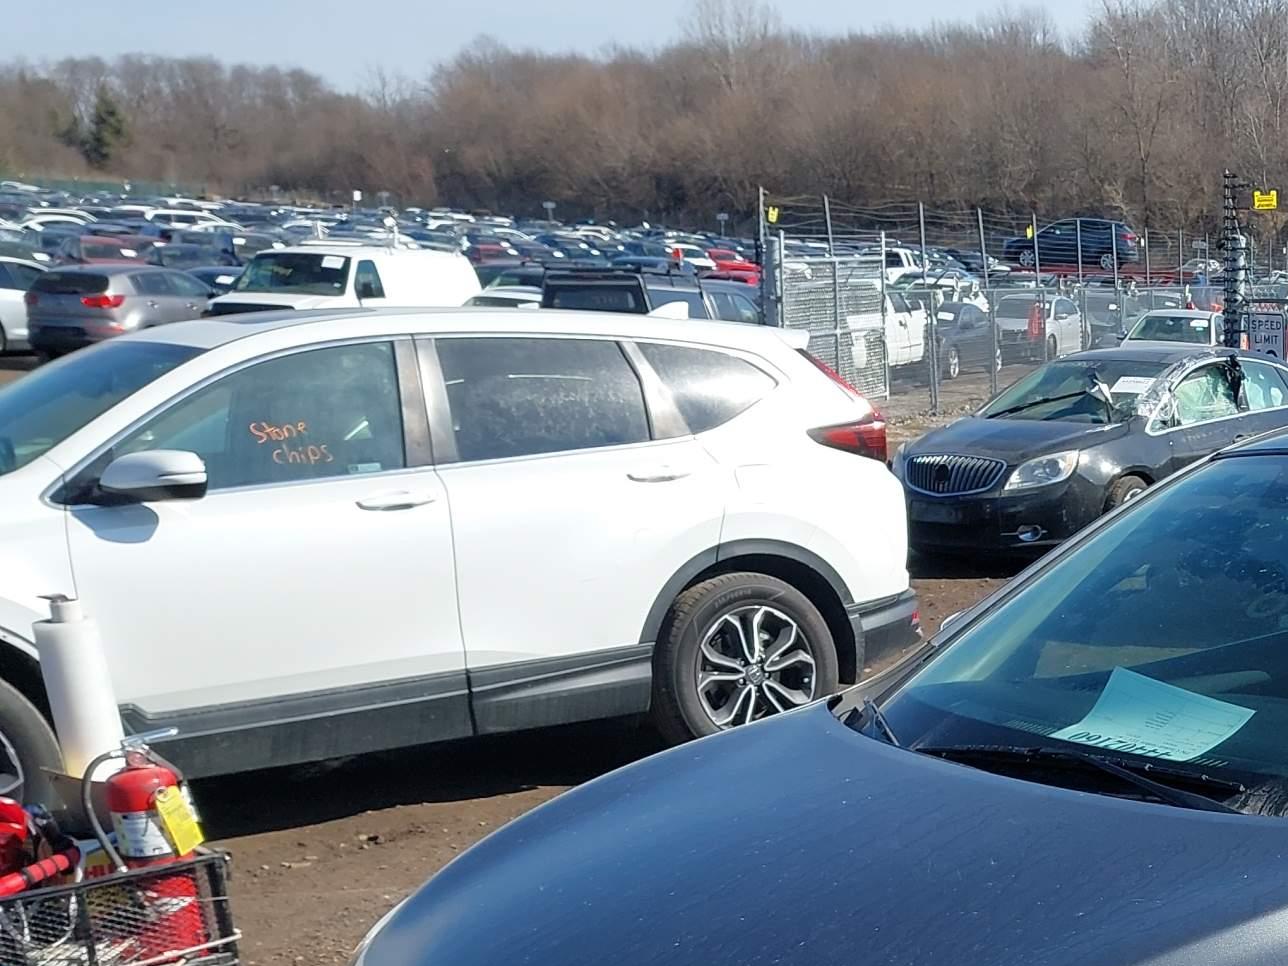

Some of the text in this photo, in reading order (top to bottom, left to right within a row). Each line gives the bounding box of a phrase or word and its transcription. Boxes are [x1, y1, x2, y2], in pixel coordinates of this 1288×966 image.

[1251, 319, 1281, 331] SPEED
[1254, 334, 1279, 345] LIMIT
[249, 421, 306, 444] Stone
[272, 443, 335, 465] chips
